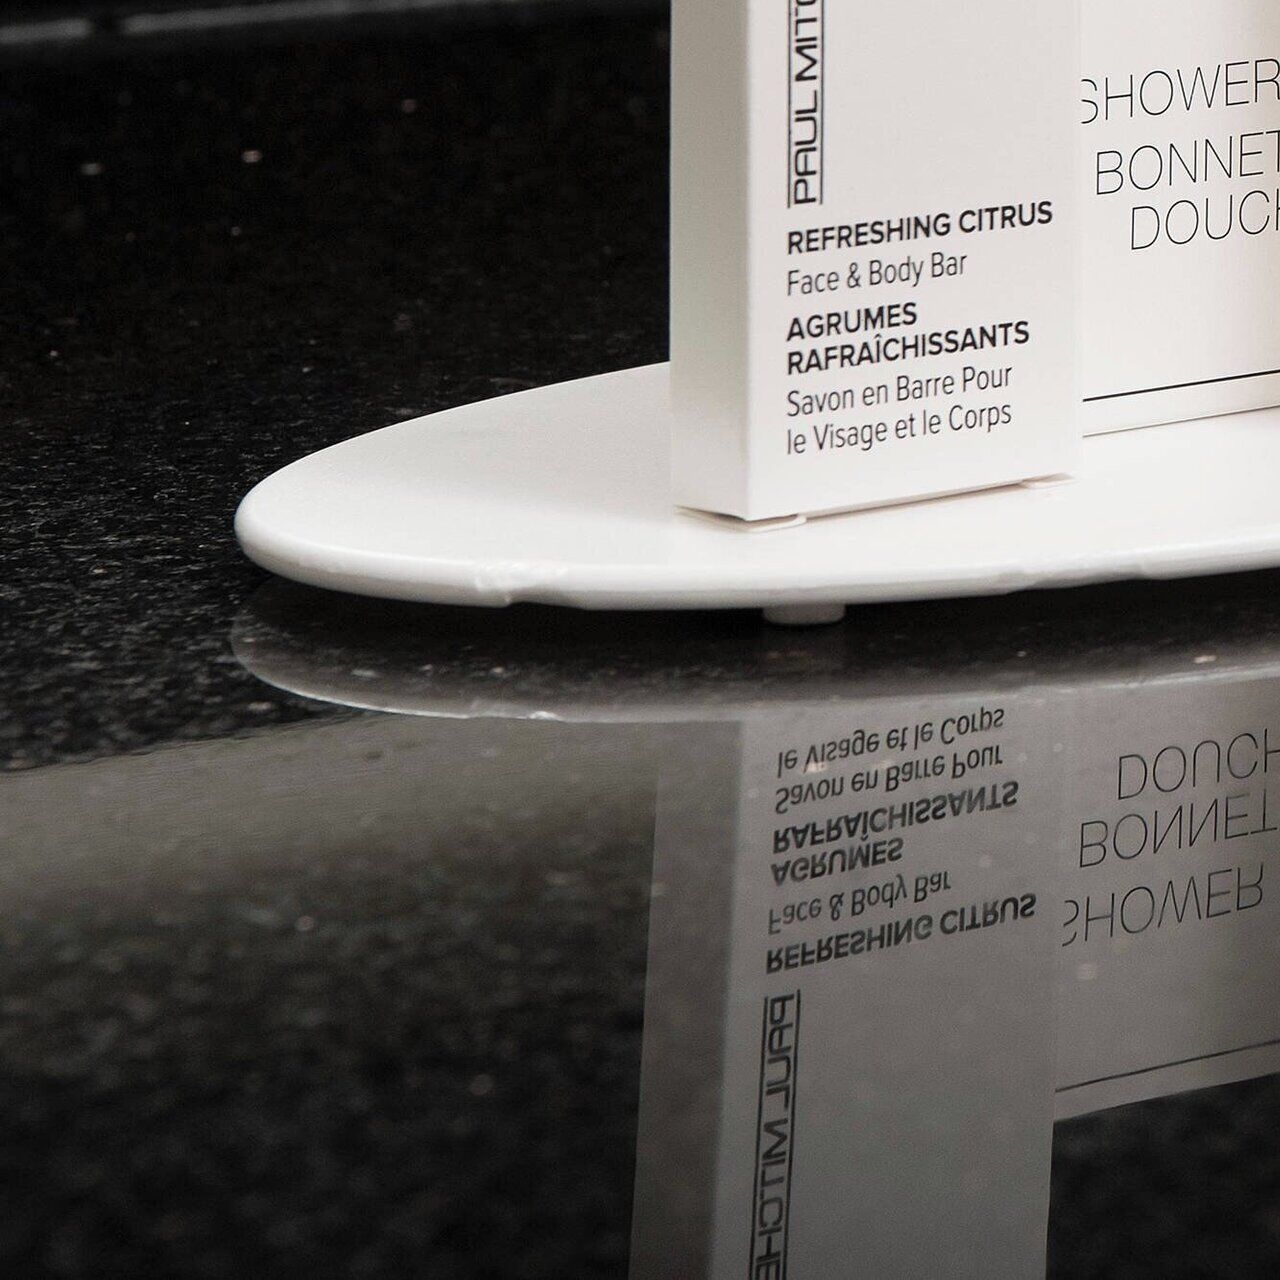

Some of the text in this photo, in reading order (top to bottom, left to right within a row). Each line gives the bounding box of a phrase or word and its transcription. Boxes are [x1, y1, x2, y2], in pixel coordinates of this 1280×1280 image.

[1081, 58, 1280, 124] SHOWER
[794, 89, 818, 205] PAUL
[787, 201, 1053, 255] REFRESHING CITRUS
[787, 251, 967, 296] Face & Body Bar
[786, 302, 917, 342] AGRUMES
[788, 321, 1030, 375] RAFRAÎCHISSANTS
[787, 365, 1012, 417] Savon en Barre Pour
[787, 404, 1012, 455] le Visage et le Corps
